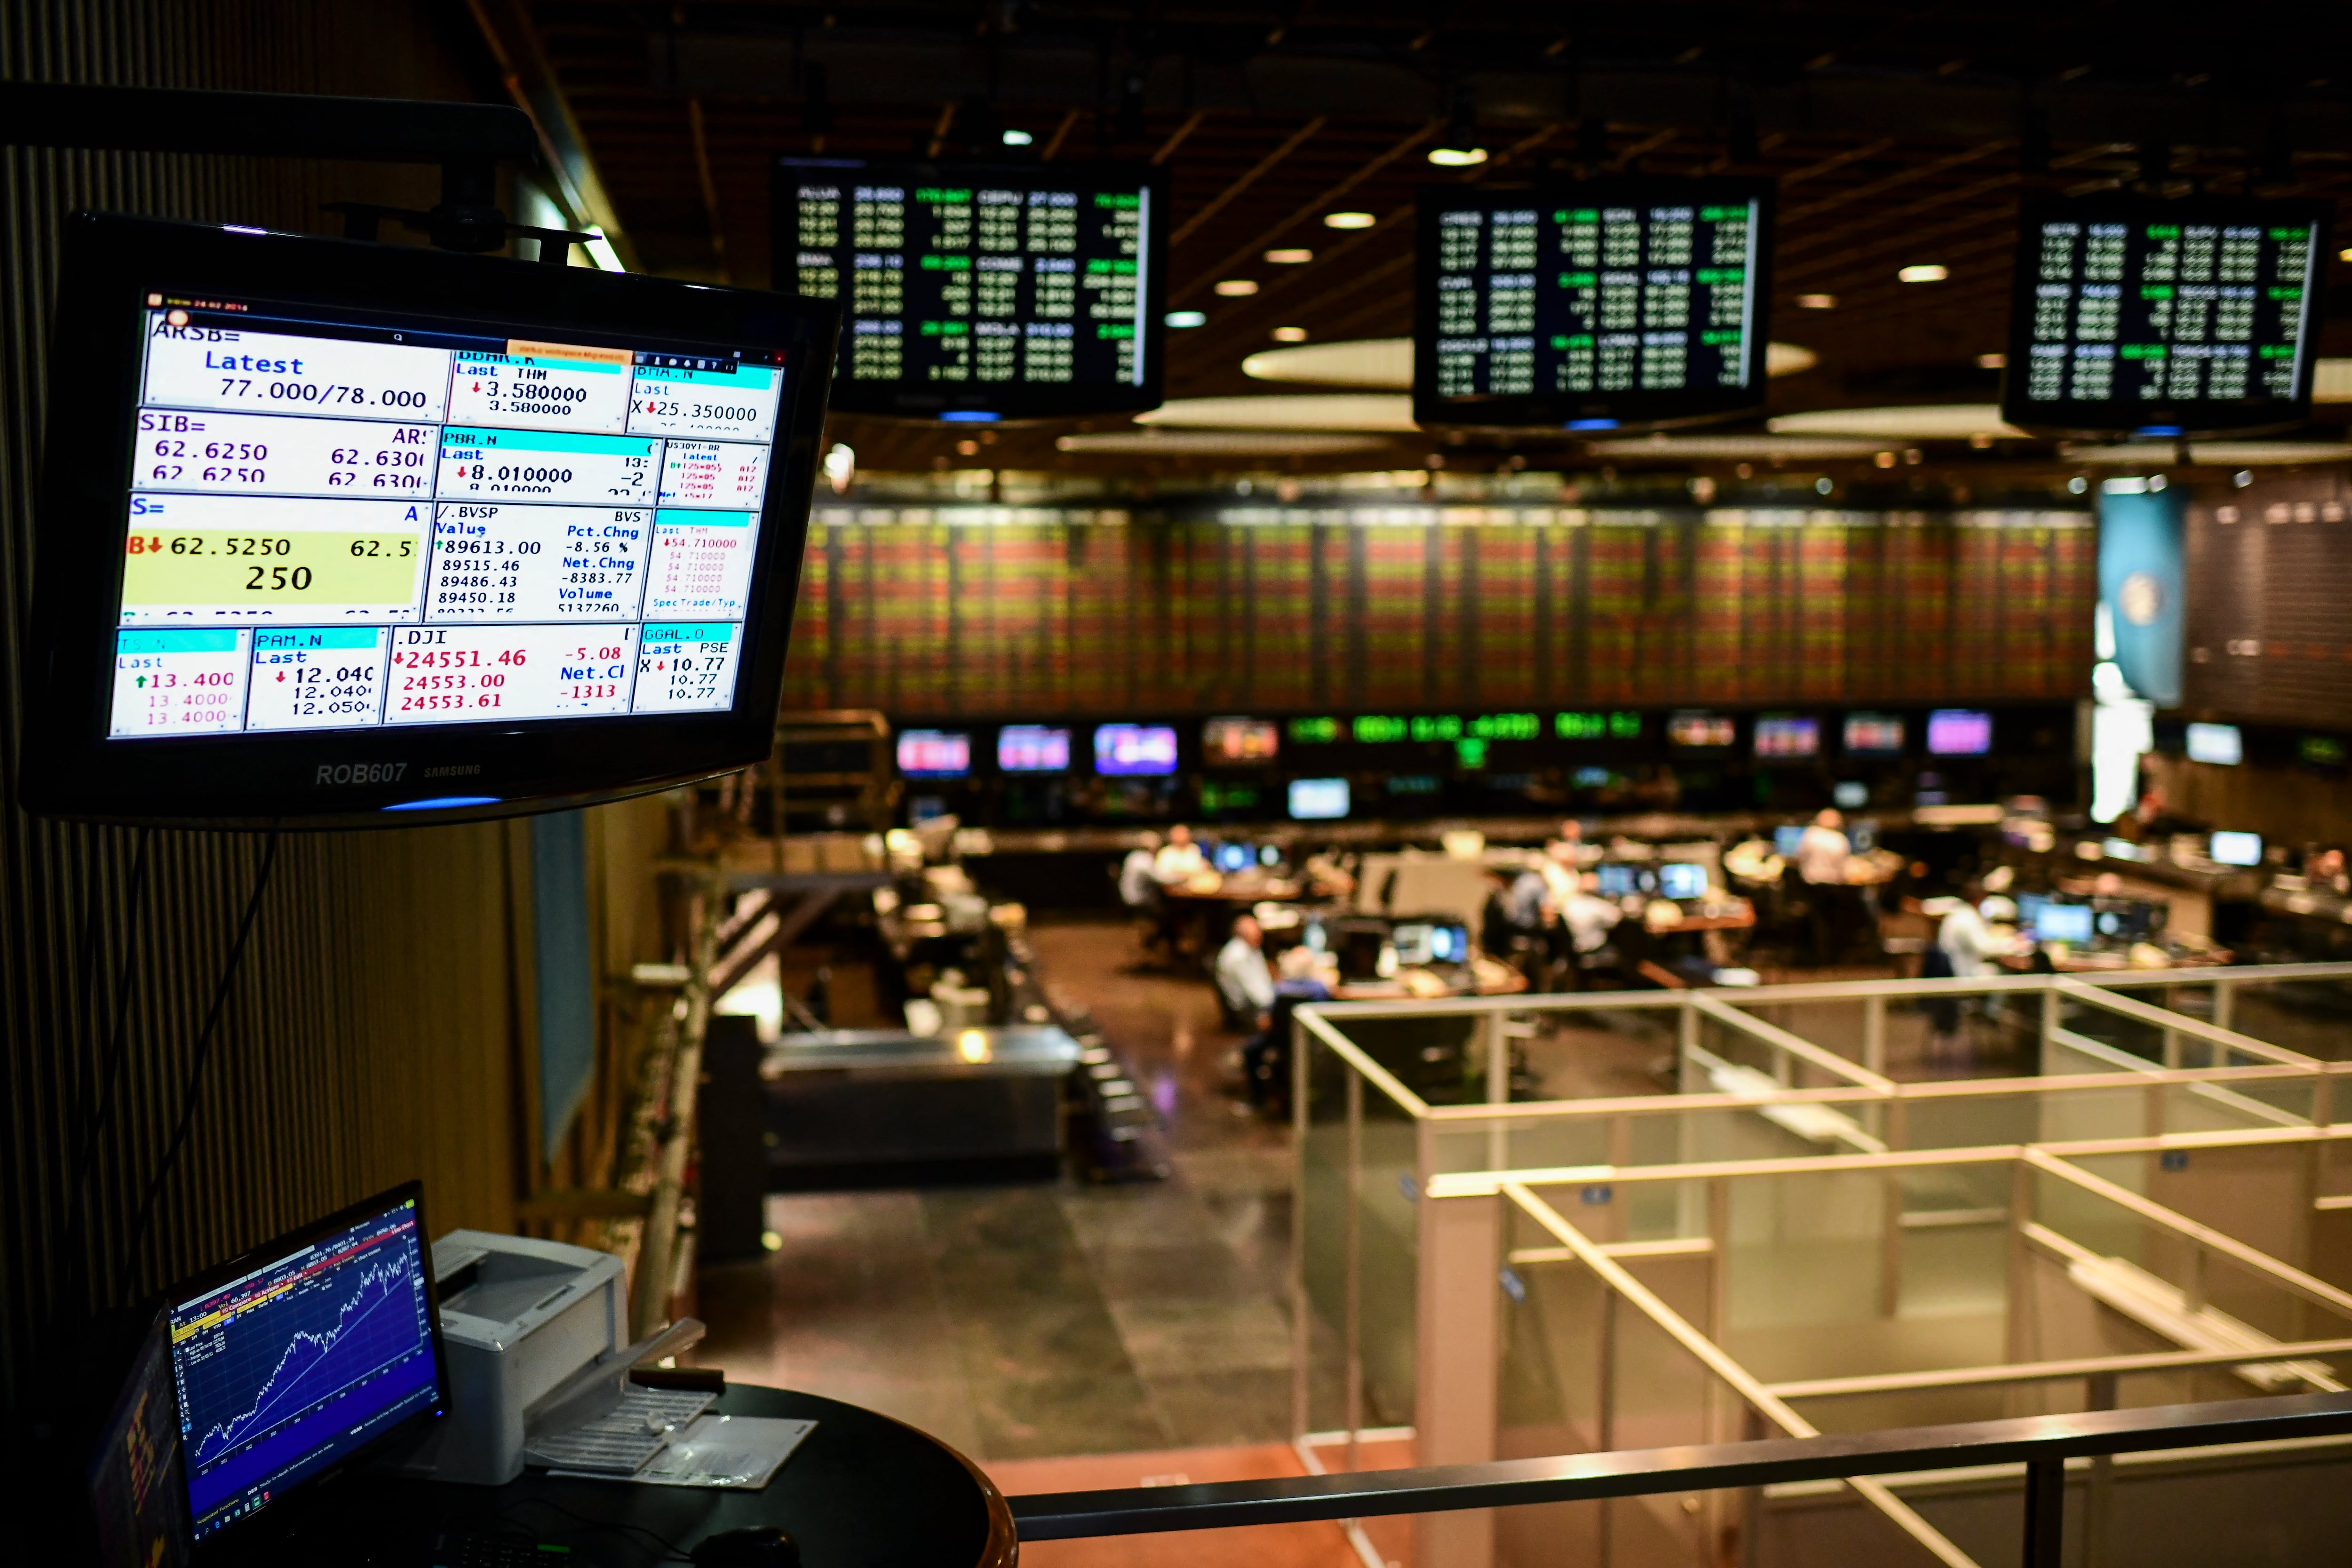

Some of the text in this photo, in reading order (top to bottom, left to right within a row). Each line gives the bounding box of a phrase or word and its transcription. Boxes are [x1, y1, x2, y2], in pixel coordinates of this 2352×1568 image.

[206, 350, 304, 375] Latest
[456, 363, 547, 381] Last THM
[221, 378, 427, 409] 77.000/78.000
[486, 381, 587, 403] 3.580000
[635, 382, 669, 396] Last
[489, 400, 572, 415] 3.580000
[631, 399, 757, 421] X 25.350000
[140, 414, 206, 433] SIB=
[444, 432, 497, 446] PBR.N
[155, 440, 268, 461] 62.6250
[441, 448, 484, 461] Last
[152, 465, 421, 489] 626250 62630
[471, 464, 572, 483] 8.010000
[470, 483, 551, 494] 8010000
[131, 497, 418, 522] S= A
[437, 505, 641, 523] /.BVSP BVS
[436, 522, 639, 540] Value Pct.Chng
[127, 536, 418, 557] B 62.5250 62.5
[445, 540, 541, 555] 89613.00
[566, 541, 610, 553] -8.56
[671, 538, 737, 549] 54.710000
[442, 557, 635, 572] 89515.46 Net.Chng
[246, 565, 313, 590] 250
[440, 572, 633, 588] 89486.43 -8383.77
[438, 588, 612, 604] 89450.18 Volume
[256, 633, 323, 649] PAM.N
[397, 630, 447, 645] .DJI
[645, 629, 704, 640] GGAL.O
[642, 642, 729, 654] Last PSE
[119, 656, 163, 669] Last
[255, 651, 308, 665] Last
[405, 646, 621, 669] 24551.46 -5.08
[640, 657, 725, 672] X 10.77
[403, 673, 505, 691] 24553.00
[671, 674, 717, 685] 10.77
[294, 685, 372, 699] 12.040
[560, 684, 616, 700] -1313
[669, 687, 715, 700] 10.77
[293, 700, 371, 715] 12.050
[400, 693, 502, 711] 24553.61
[316, 762, 408, 785] ROB607
[424, 764, 481, 778] SAMSUNG
[229, 1296, 252, 1310] Compare
[261, 1284, 280, 1296] Actions
[189, 1311, 207, 1323] 13:00
[218, 1301, 228, 1309] Vol
[230, 1290, 251, 1304] 66,397
[197, 1509, 219, 1525] Suggested
[219, 1498, 239, 1512] Functions
[247, 1486, 258, 1496] DES
[260, 1479, 271, 1488] Study
